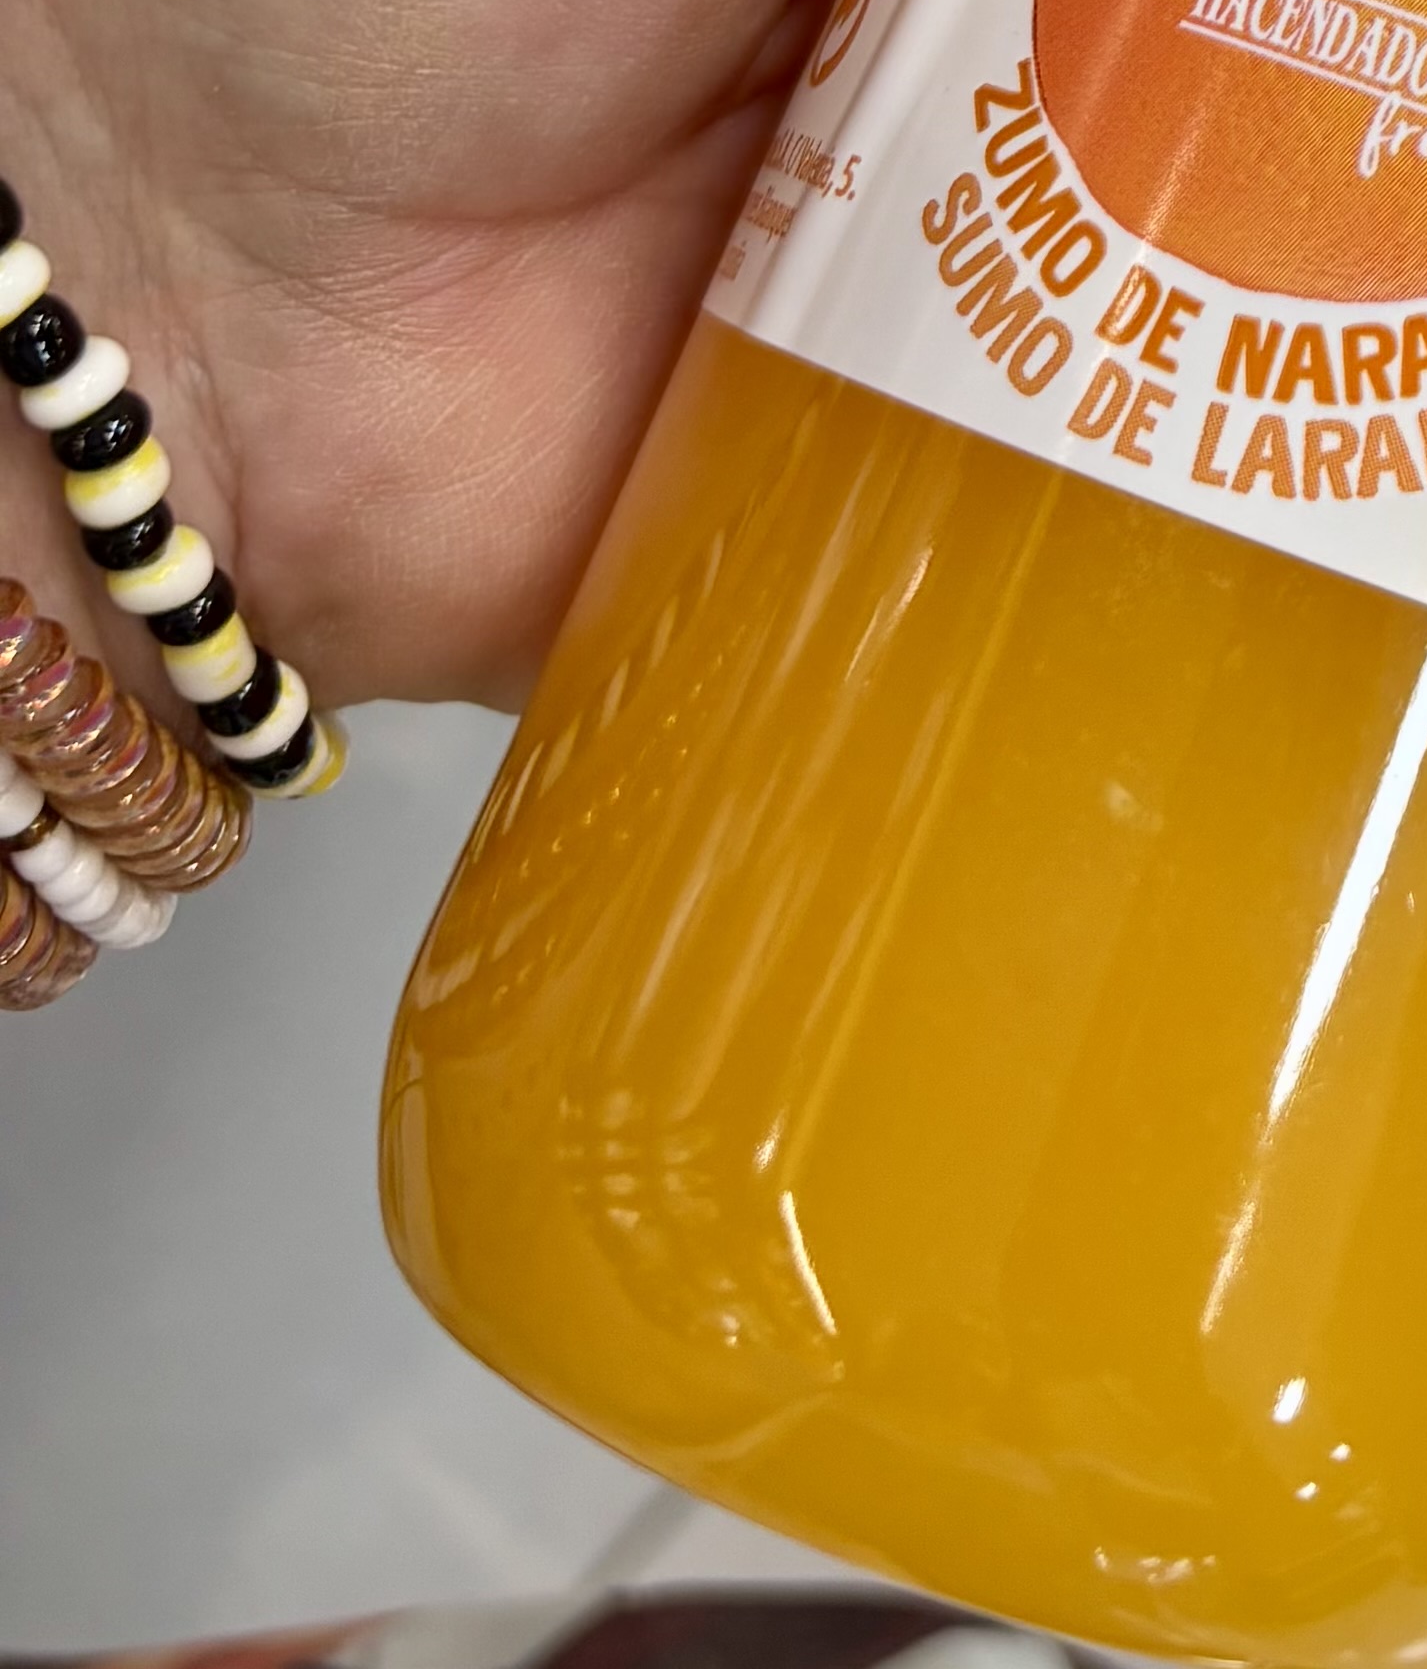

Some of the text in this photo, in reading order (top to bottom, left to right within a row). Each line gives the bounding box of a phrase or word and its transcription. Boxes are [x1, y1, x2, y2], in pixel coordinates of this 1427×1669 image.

[920, 171, 1075, 399] SUMO
[1064, 353, 1176, 468] DE
[973, 56, 1110, 300] ZUMO
[1093, 263, 1206, 375] DE
